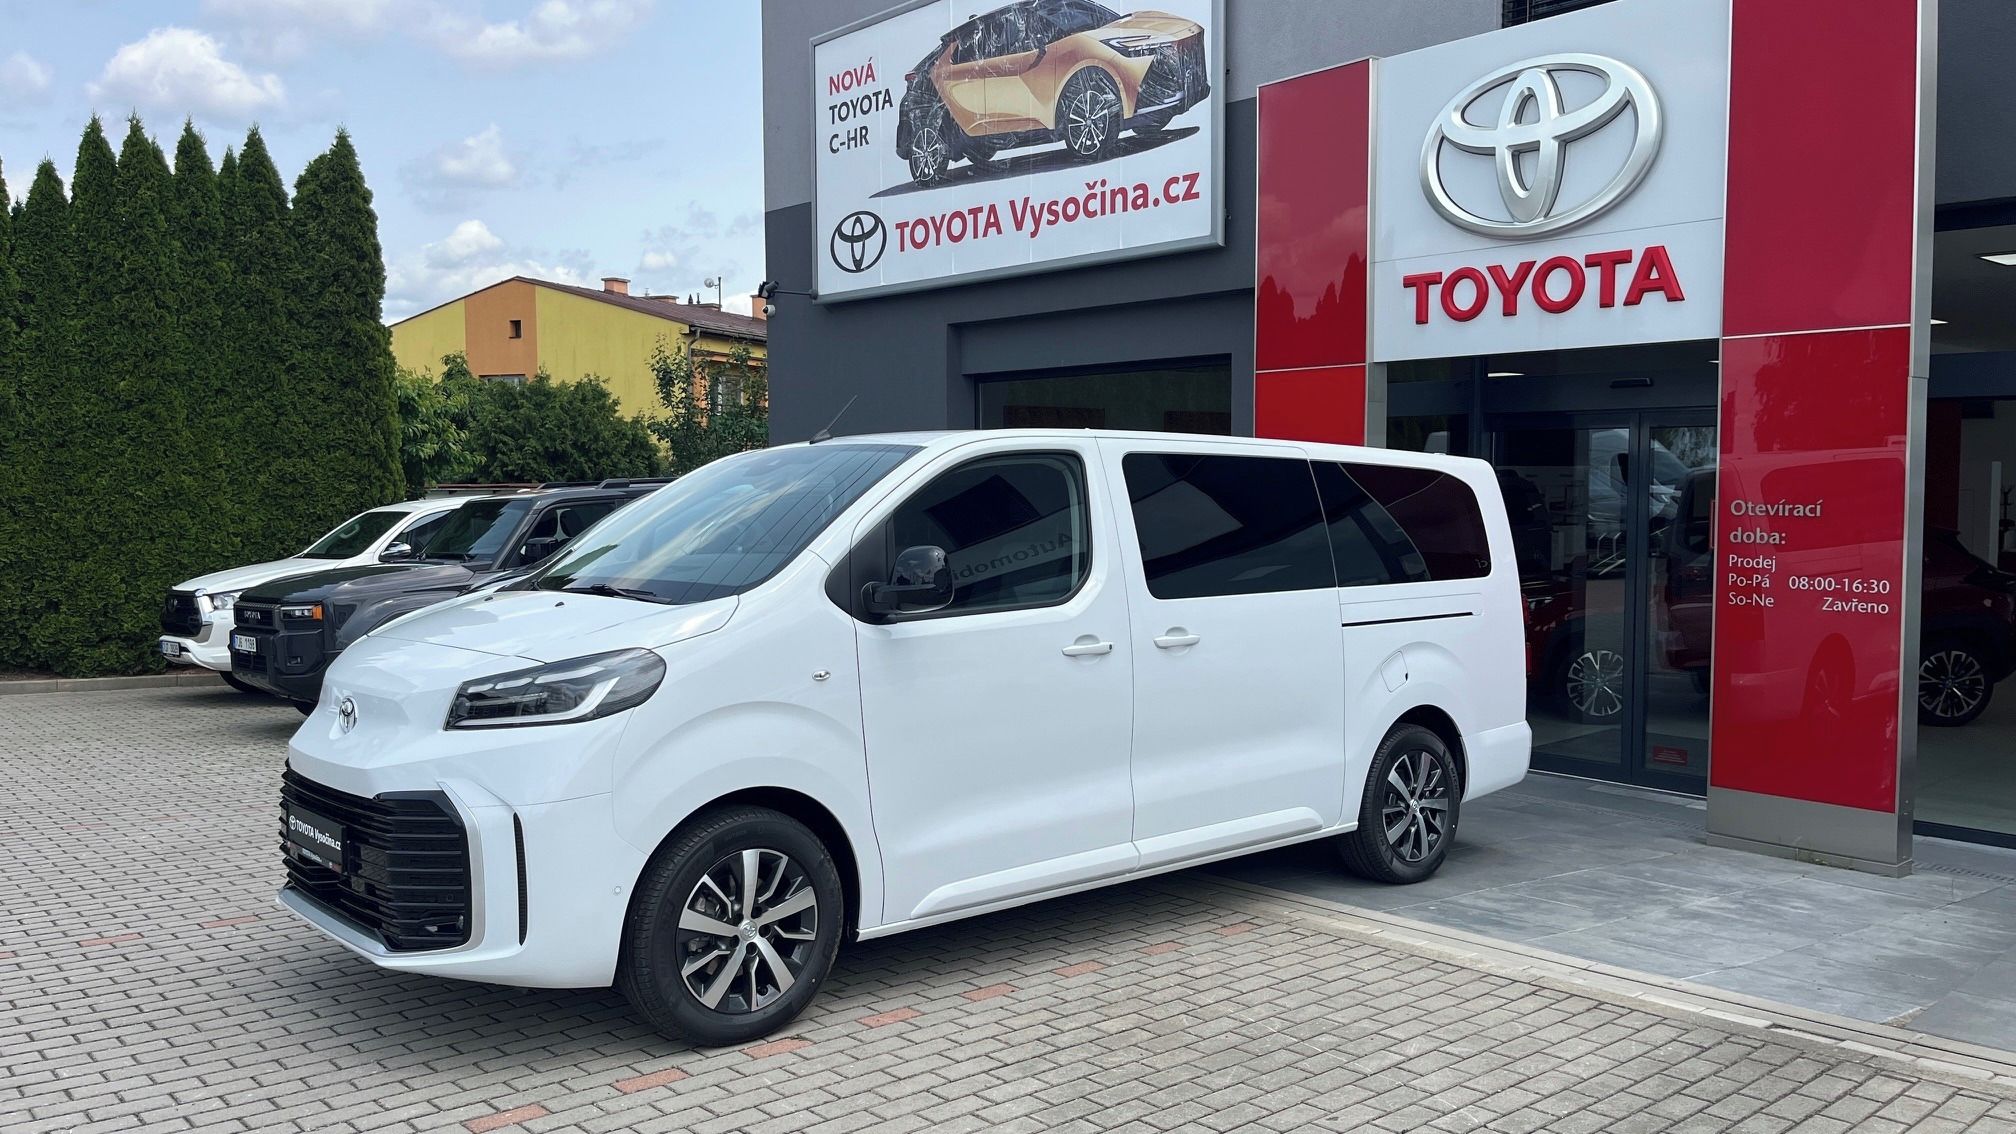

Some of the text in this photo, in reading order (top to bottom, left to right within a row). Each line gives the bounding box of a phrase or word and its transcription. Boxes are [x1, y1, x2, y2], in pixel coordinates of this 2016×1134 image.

[828, 57, 876, 96] NOVÁ
[828, 88, 894, 125] TOYOTA
[828, 125, 870, 154] C-HR
[895, 172, 1201, 253] TOYOTA Vysočina.cz
[1402, 245, 1686, 325] TOYOTA
[1730, 499, 1824, 517] Otevírací
[1729, 527, 1786, 545] doba:
[1728, 554, 1776, 572] Prodej
[1728, 573, 1890, 594] Po-Pá 08:00-16:30
[1728, 592, 1889, 614] So-Ne Zavřeno
[296, 819, 342, 851] TOYOTA Vysočina.cz
